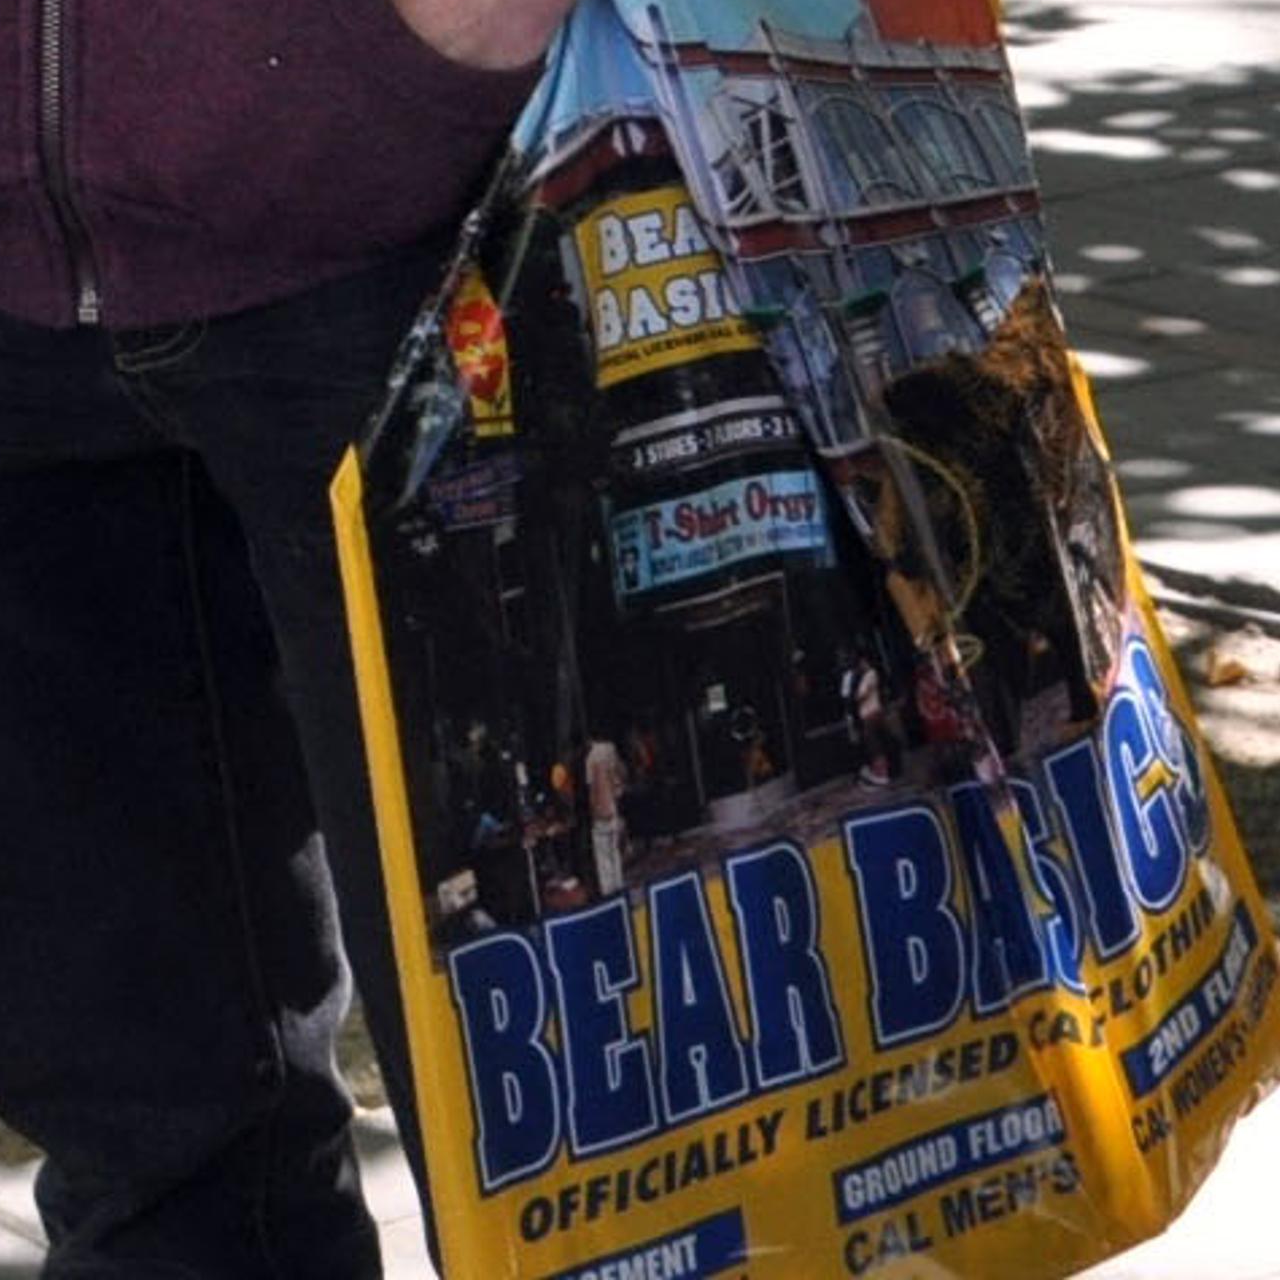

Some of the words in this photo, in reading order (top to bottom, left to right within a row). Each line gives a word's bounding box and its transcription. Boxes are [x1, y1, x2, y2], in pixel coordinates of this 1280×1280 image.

[446, 838, 845, 1197] BEAR
[1147, 1003, 1203, 1077] 2ND
[521, 1107, 786, 1241] OFFICIALLY
[806, 1030, 1020, 1141] LICENSED
[843, 1134, 958, 1209] GROUND
[967, 1096, 1065, 1160] FLOOR
[844, 1212, 934, 1276] CAL
[940, 1151, 1079, 1237] MEN'S
